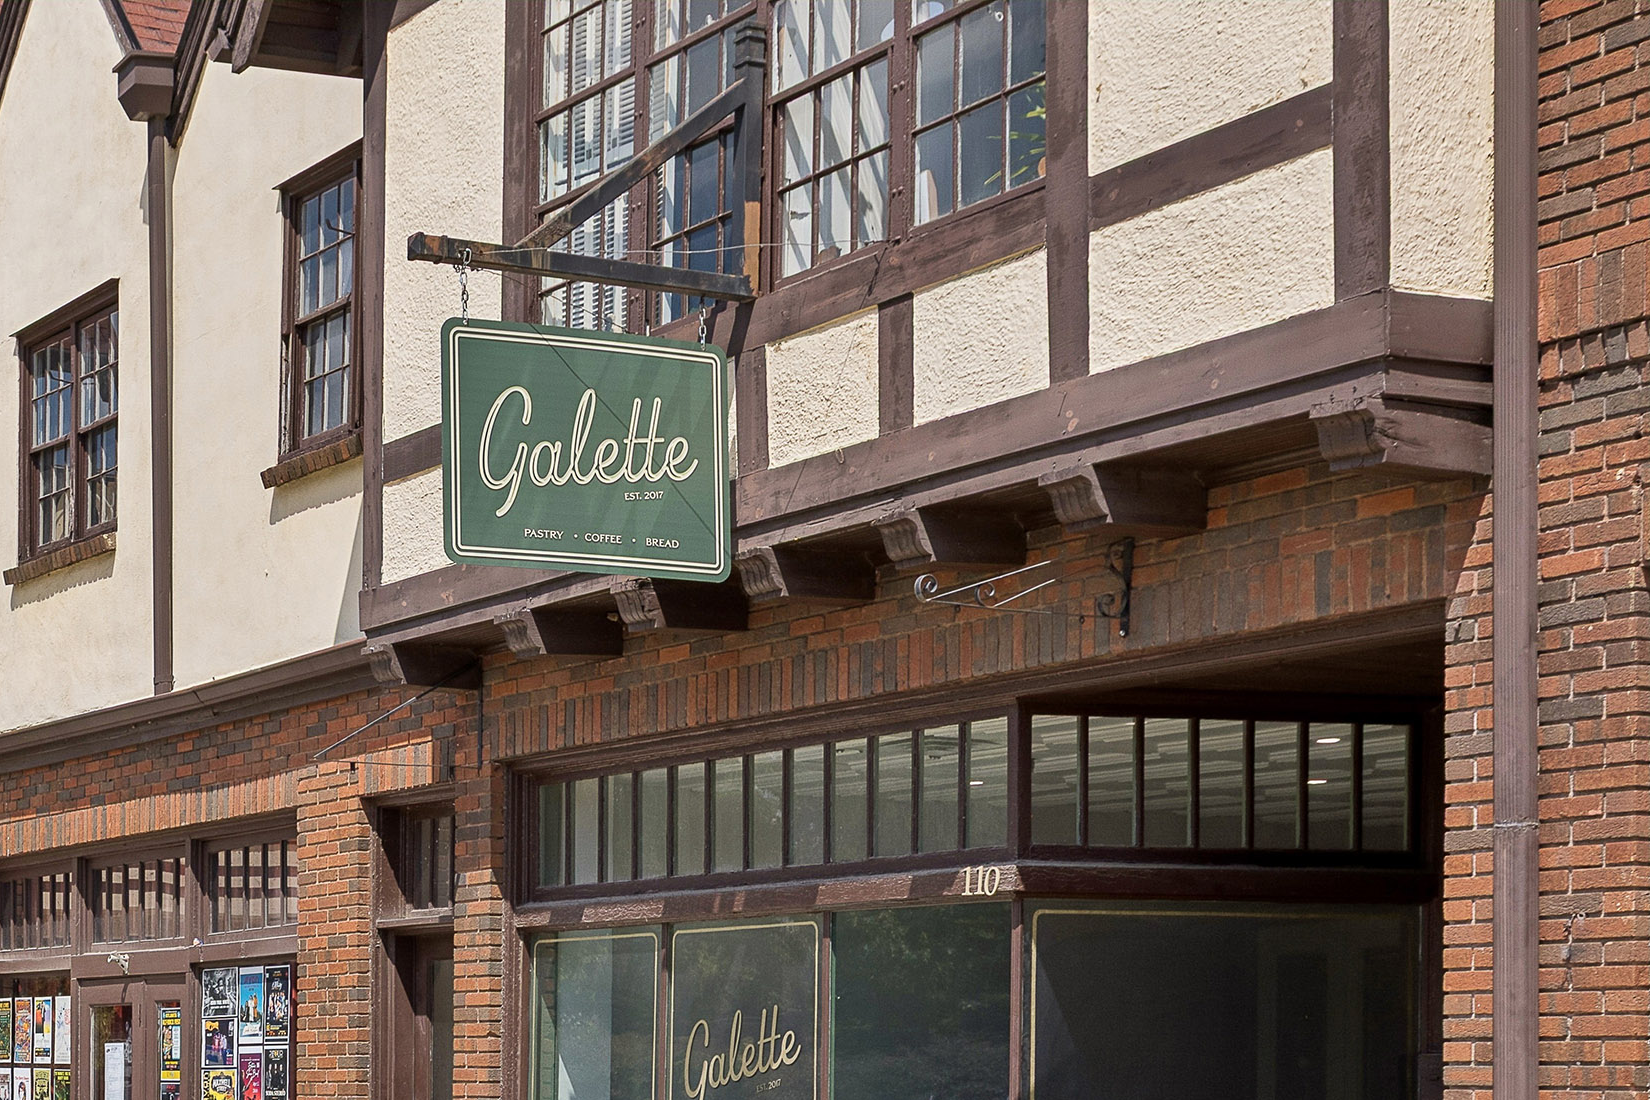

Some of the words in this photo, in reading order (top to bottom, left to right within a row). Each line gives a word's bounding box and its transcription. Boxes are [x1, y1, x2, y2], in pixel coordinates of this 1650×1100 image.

[478, 385, 699, 517] Galette
[624, 492, 643, 501] EST.
[644, 491, 664, 500] 2017
[524, 528, 564, 540] PASTRY
[584, 533, 622, 544] COFFEE
[645, 537, 680, 549] BREAD
[961, 865, 1001, 896] 110
[768, 1078, 782, 1092] 2017
